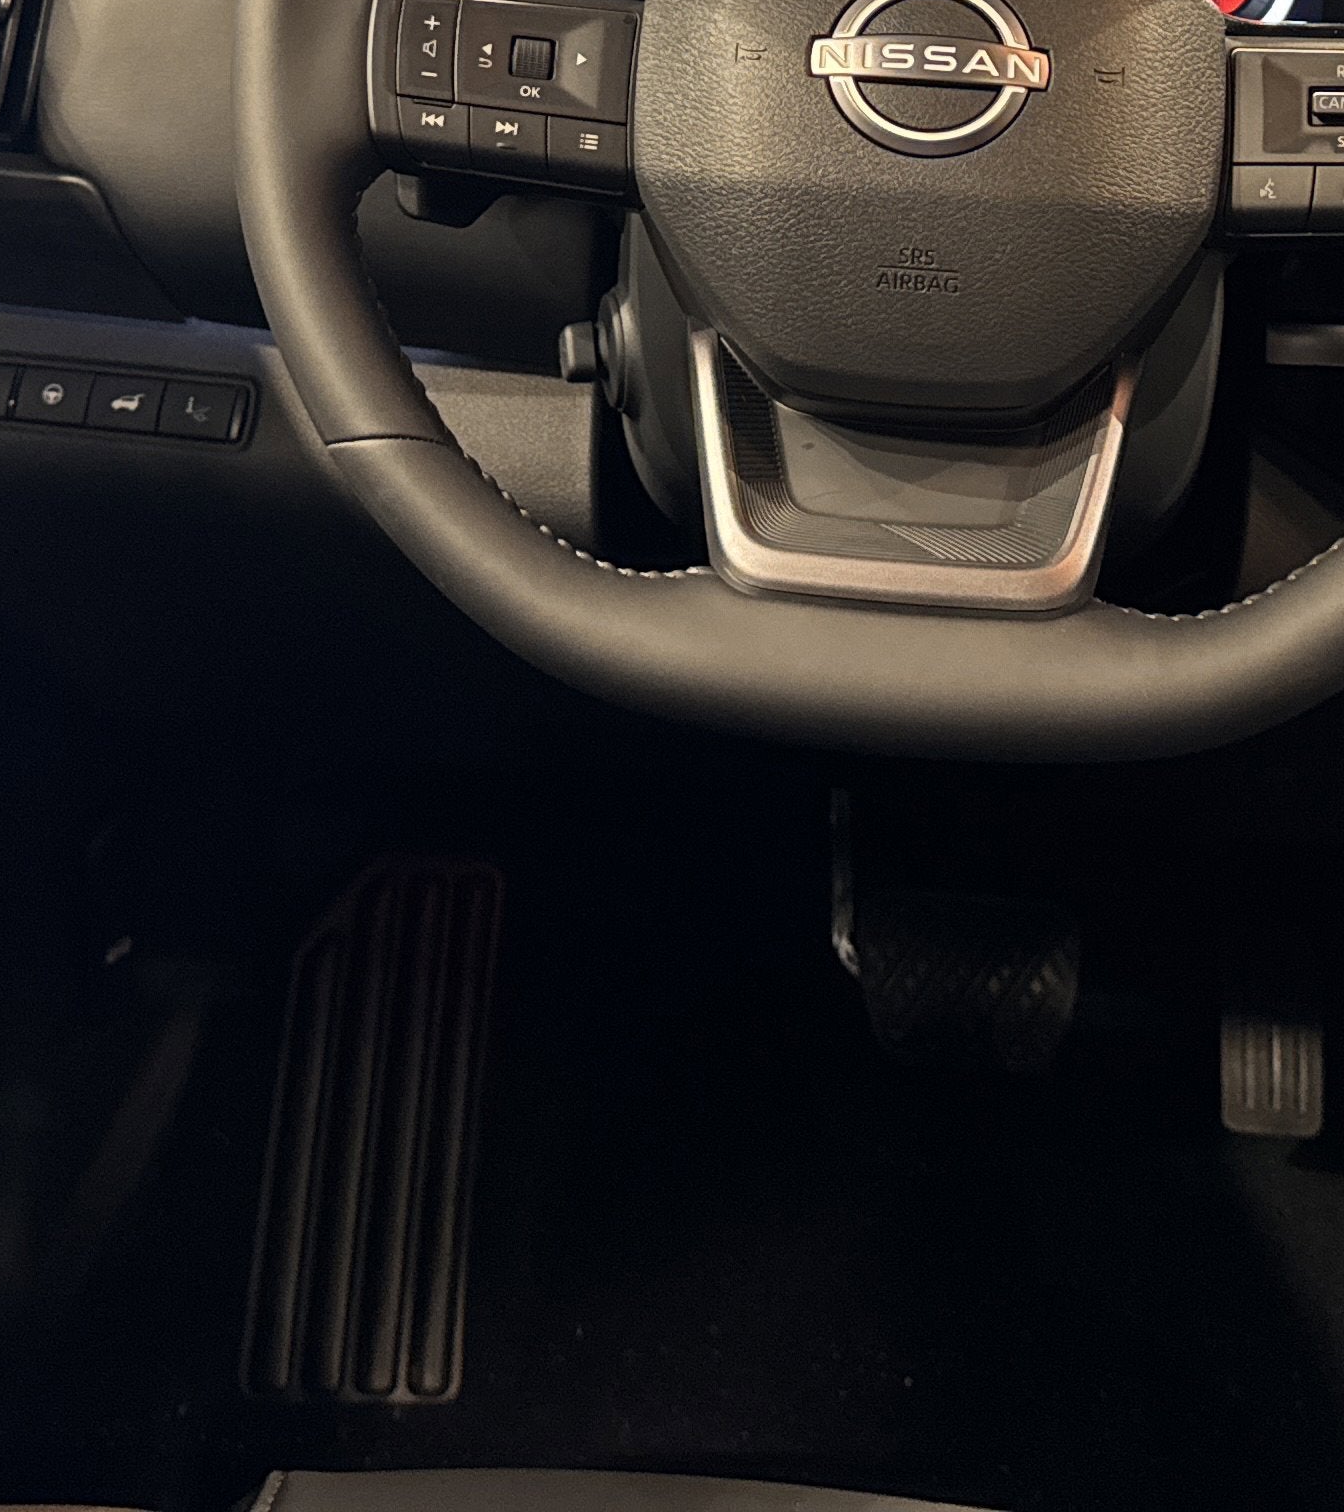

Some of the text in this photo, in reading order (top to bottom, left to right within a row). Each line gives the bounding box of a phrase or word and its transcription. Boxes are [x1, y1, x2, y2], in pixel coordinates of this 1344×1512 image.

[818, 42, 1042, 84] NISSAN
[519, 85, 541, 99] OK
[898, 247, 936, 266] SRS
[876, 272, 959, 294] AIRBAG
